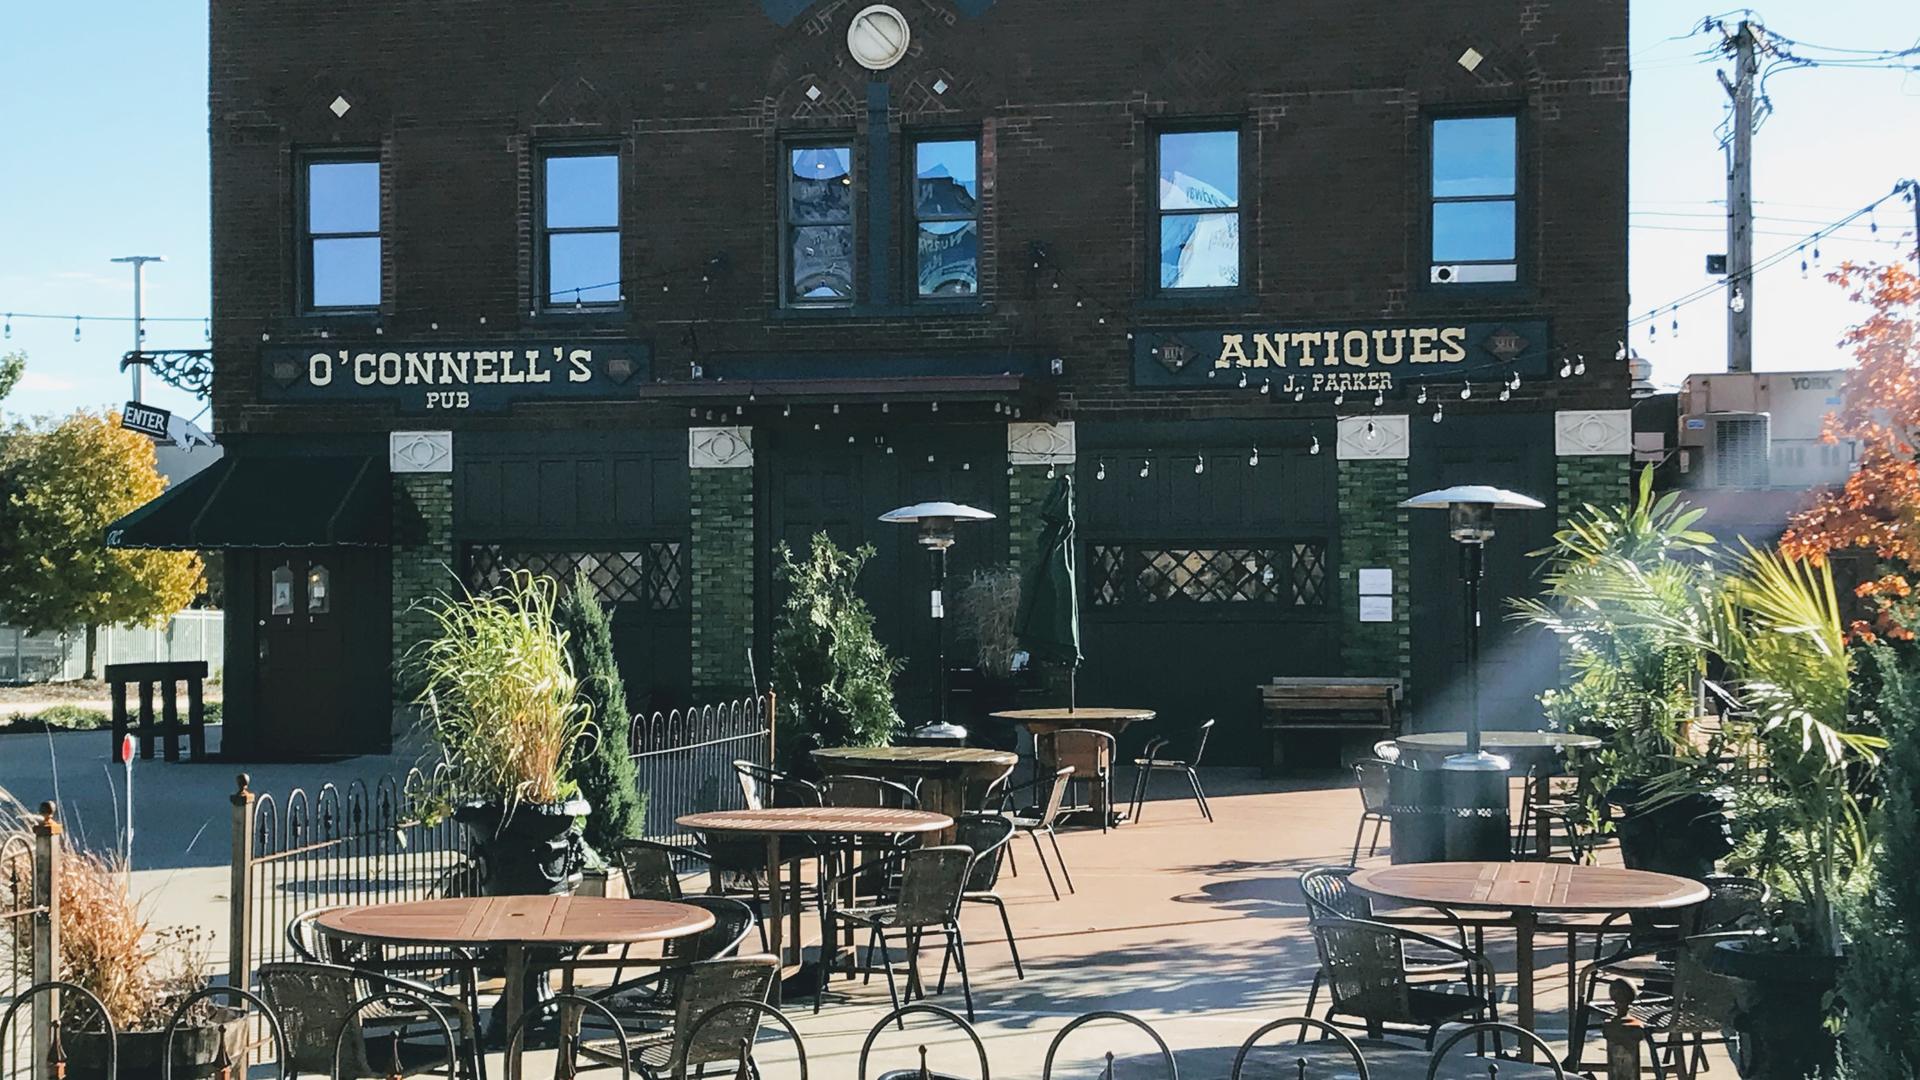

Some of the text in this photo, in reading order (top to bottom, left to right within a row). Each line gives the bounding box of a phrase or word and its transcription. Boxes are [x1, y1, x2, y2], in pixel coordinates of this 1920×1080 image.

[1214, 327, 1467, 368] ANTIQUES
[309, 347, 592, 386] O'CONNELL'S
[1312, 371, 1393, 392] PARKER
[1792, 377, 1832, 390] YORK
[426, 391, 470, 408] PUB
[125, 407, 164, 430] ENTER
